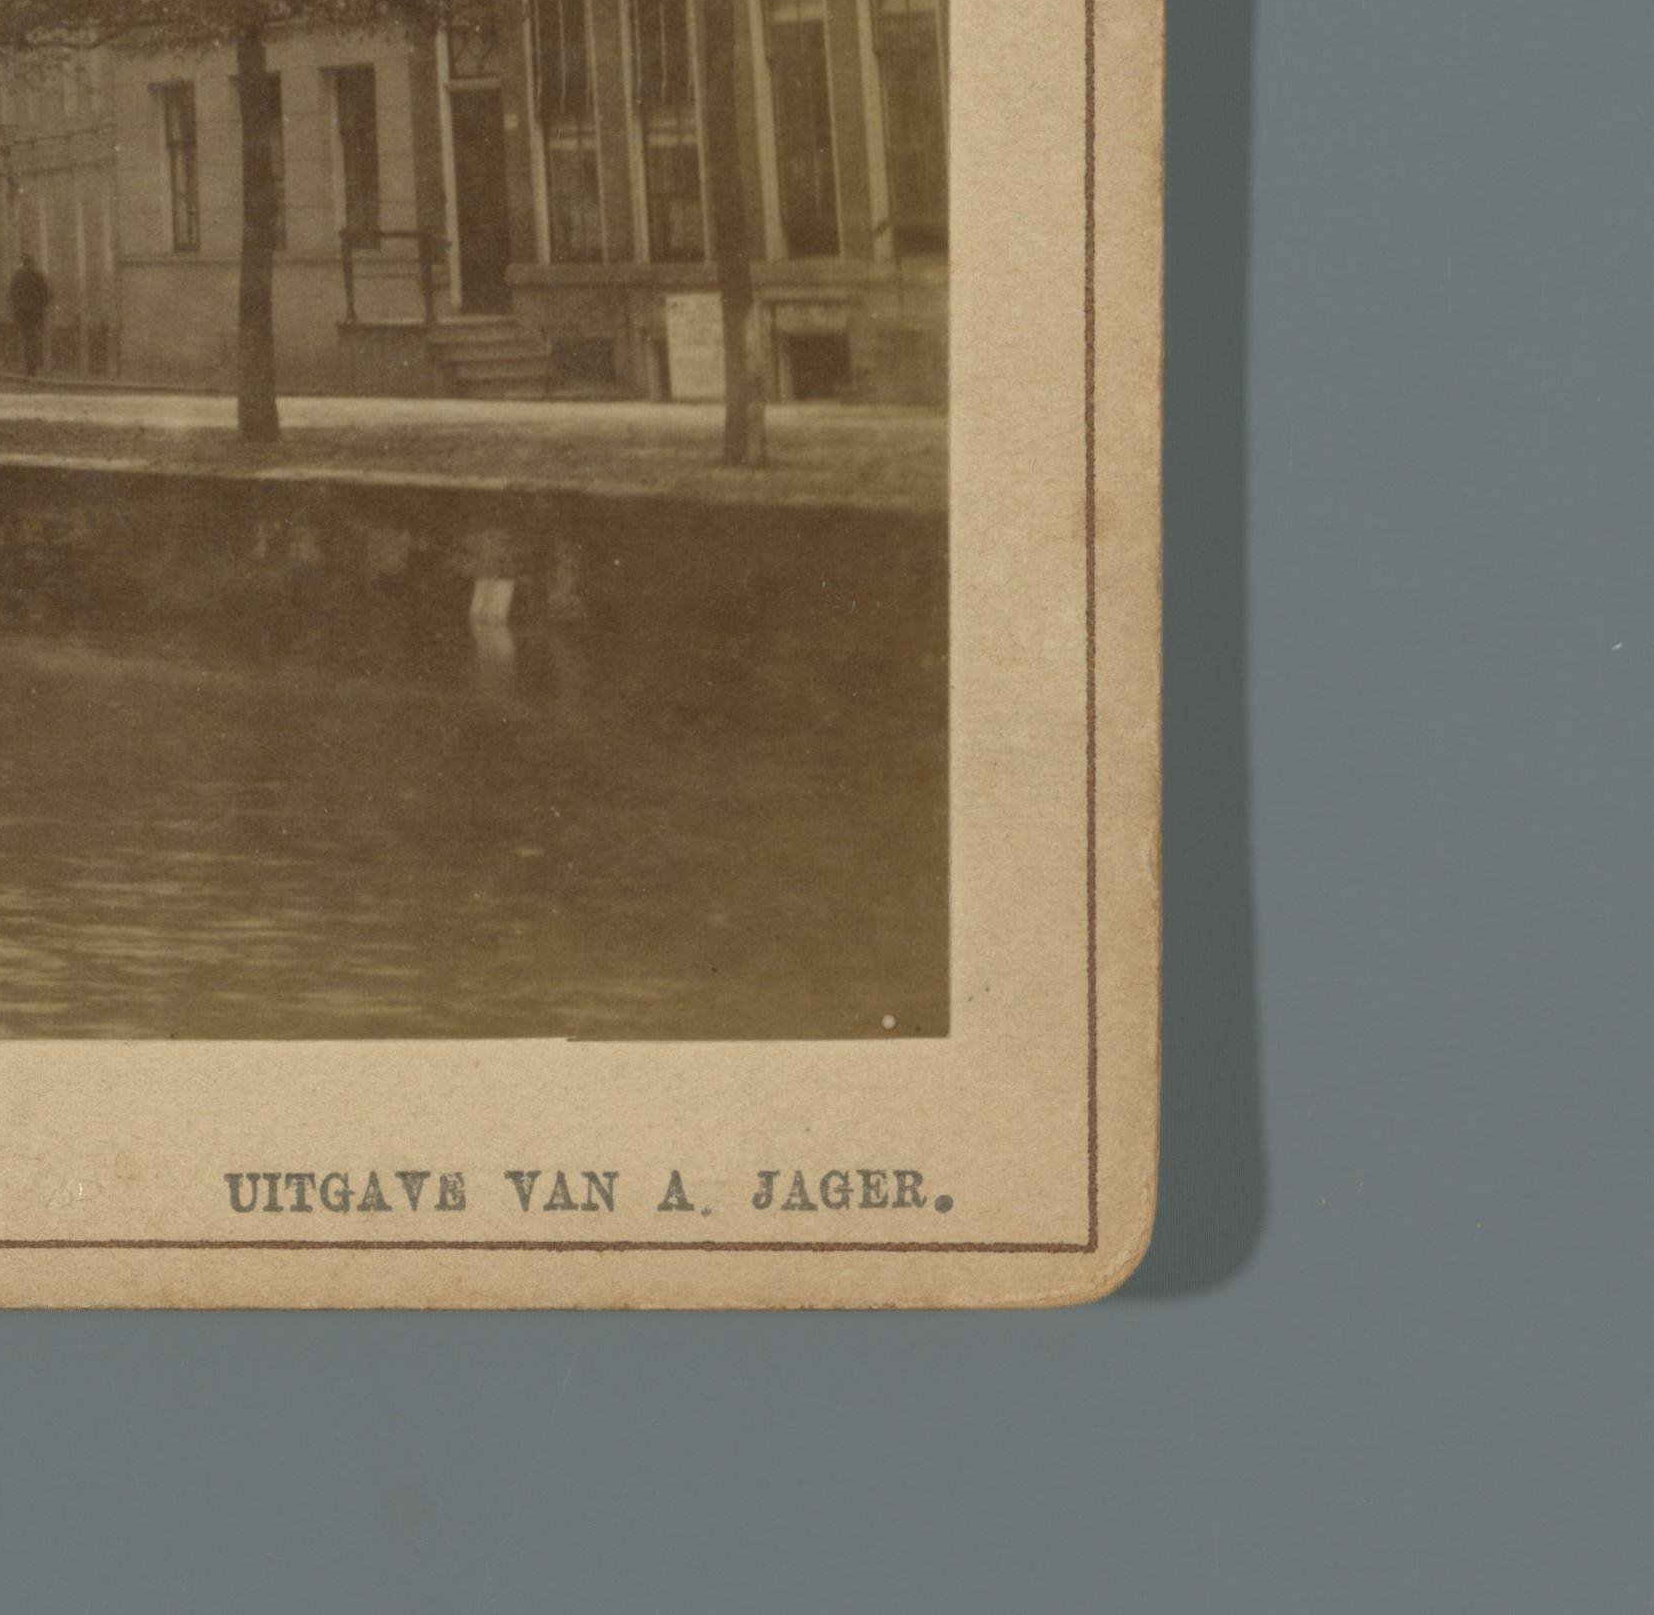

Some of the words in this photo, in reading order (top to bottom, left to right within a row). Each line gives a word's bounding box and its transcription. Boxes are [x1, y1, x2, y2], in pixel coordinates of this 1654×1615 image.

[223, 1171, 468, 1215] UITGAVE
[505, 1170, 619, 1213] VAN
[657, 1170, 716, 1217] A.
[751, 1169, 956, 1214] JAGER.
